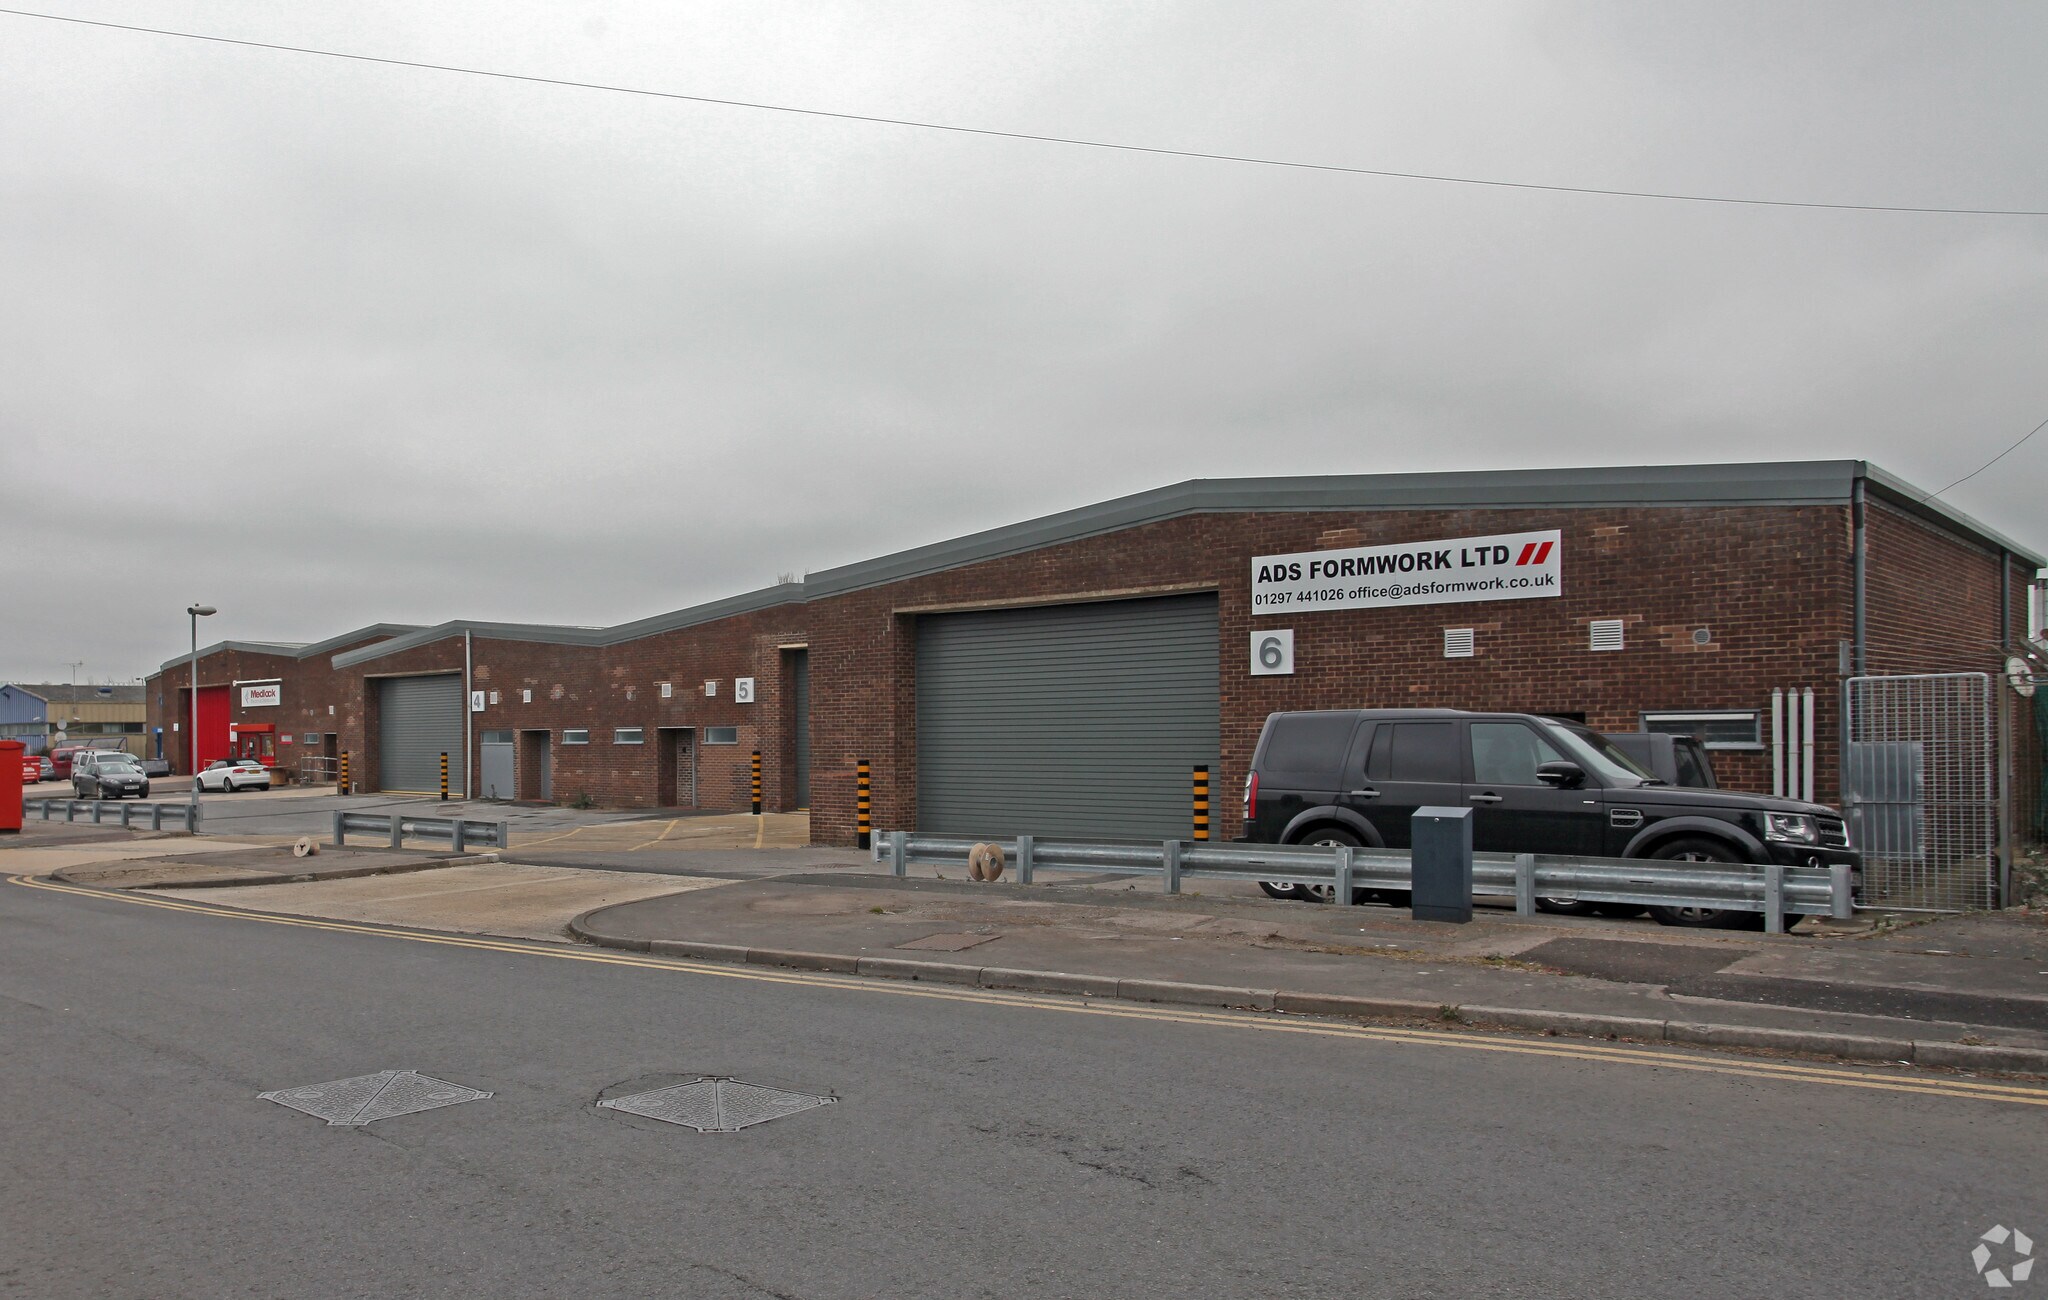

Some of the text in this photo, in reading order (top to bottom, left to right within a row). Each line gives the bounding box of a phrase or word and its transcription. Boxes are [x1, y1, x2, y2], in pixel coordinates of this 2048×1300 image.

[1258, 545, 1510, 583] ADS FORMWORK LTD
[1255, 573, 1555, 606] 01297 441026 office@adsformwork.co.uk
[1258, 637, 1284, 670] 6
[250, 688, 276, 698] Medlock
[473, 694, 481, 708] 4
[738, 681, 749, 700] 5
